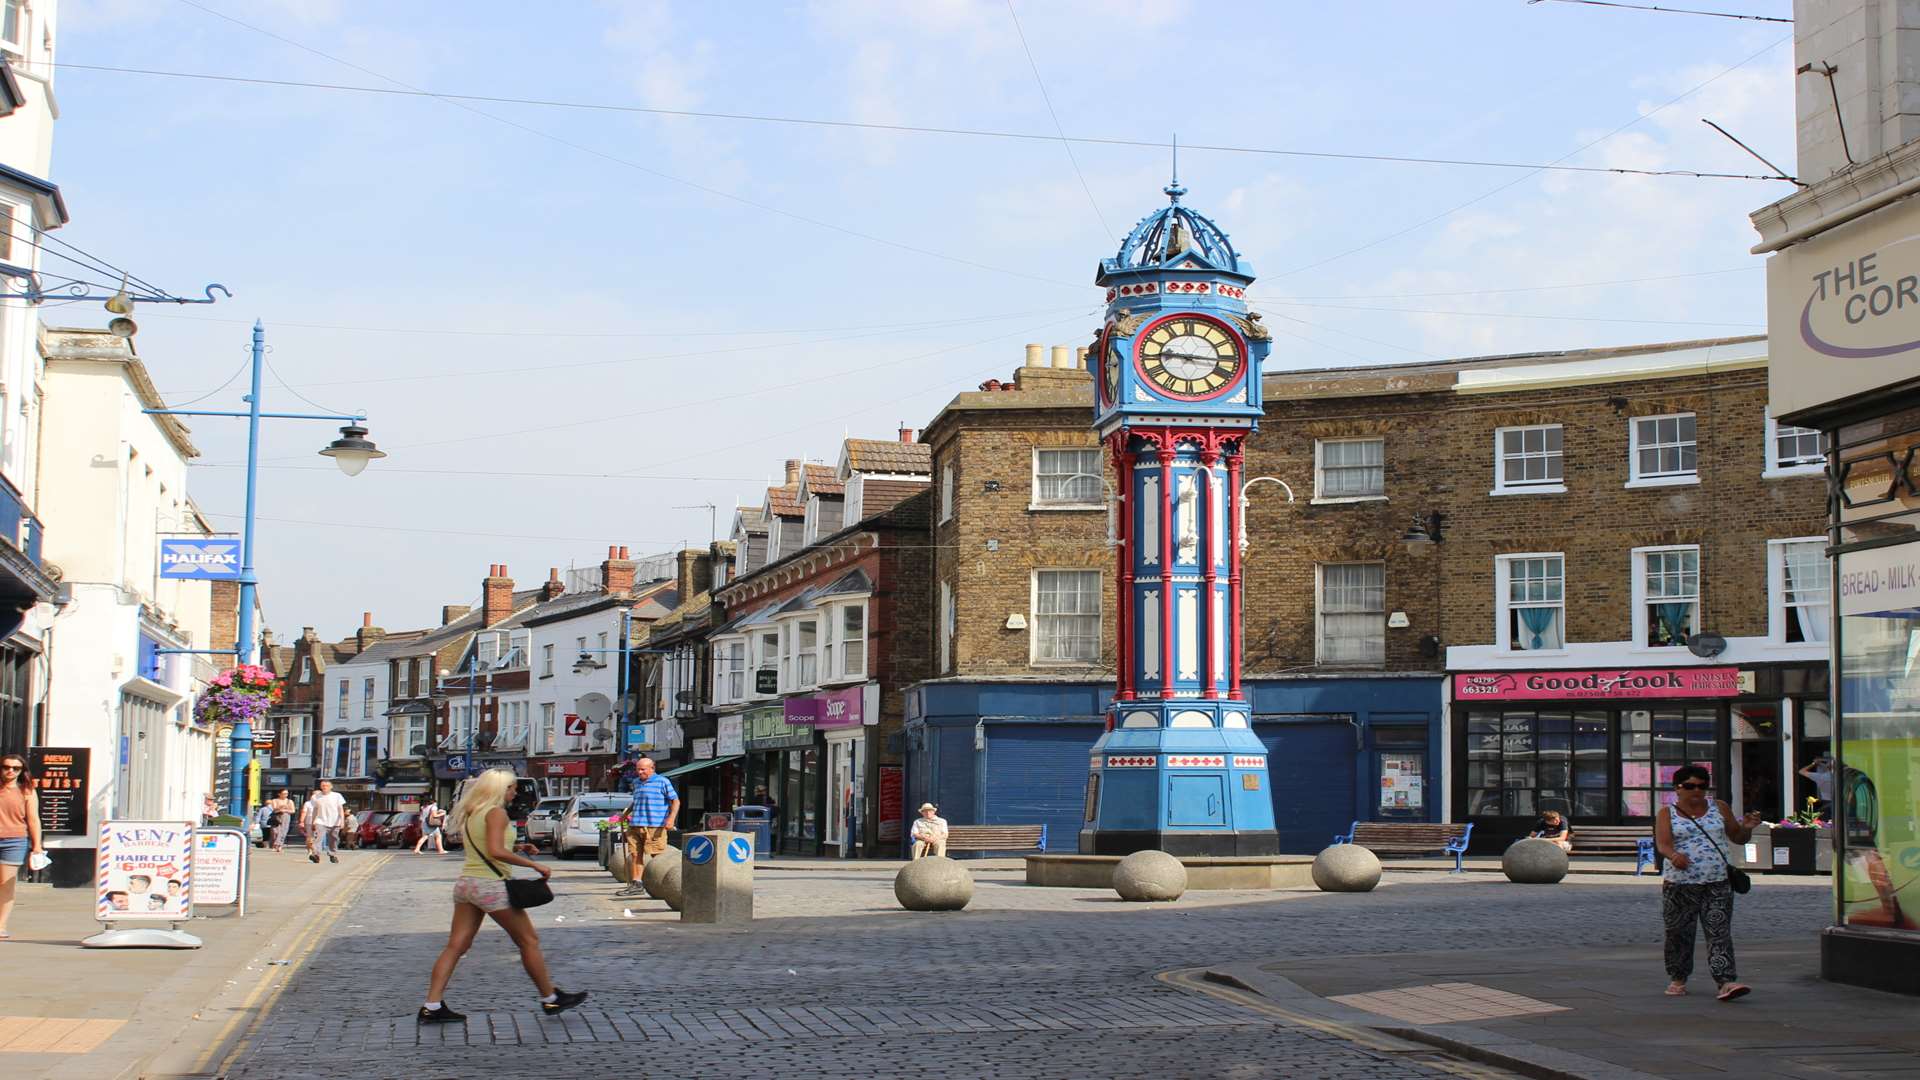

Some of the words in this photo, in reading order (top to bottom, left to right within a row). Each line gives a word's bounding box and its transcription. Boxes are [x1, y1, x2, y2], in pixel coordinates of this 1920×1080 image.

[1812, 252, 1878, 301] THE
[1845, 275, 1919, 325] COR
[163, 553, 238, 564] HALIFAX
[1842, 569, 1879, 597] BREAD
[1888, 563, 1916, 591] MILK
[1526, 674, 1599, 690] Good
[1618, 671, 1684, 690] Look
[1692, 673, 1736, 682] UNISEX
[826, 698, 845, 719] Scope
[788, 714, 815, 722] Scope
[44, 754, 73, 762] NEW!
[32, 778, 82, 788] TWIST
[116, 829, 177, 843] KENT
[115, 854, 149, 862] HAIR
[152, 854, 177, 862] CUT
